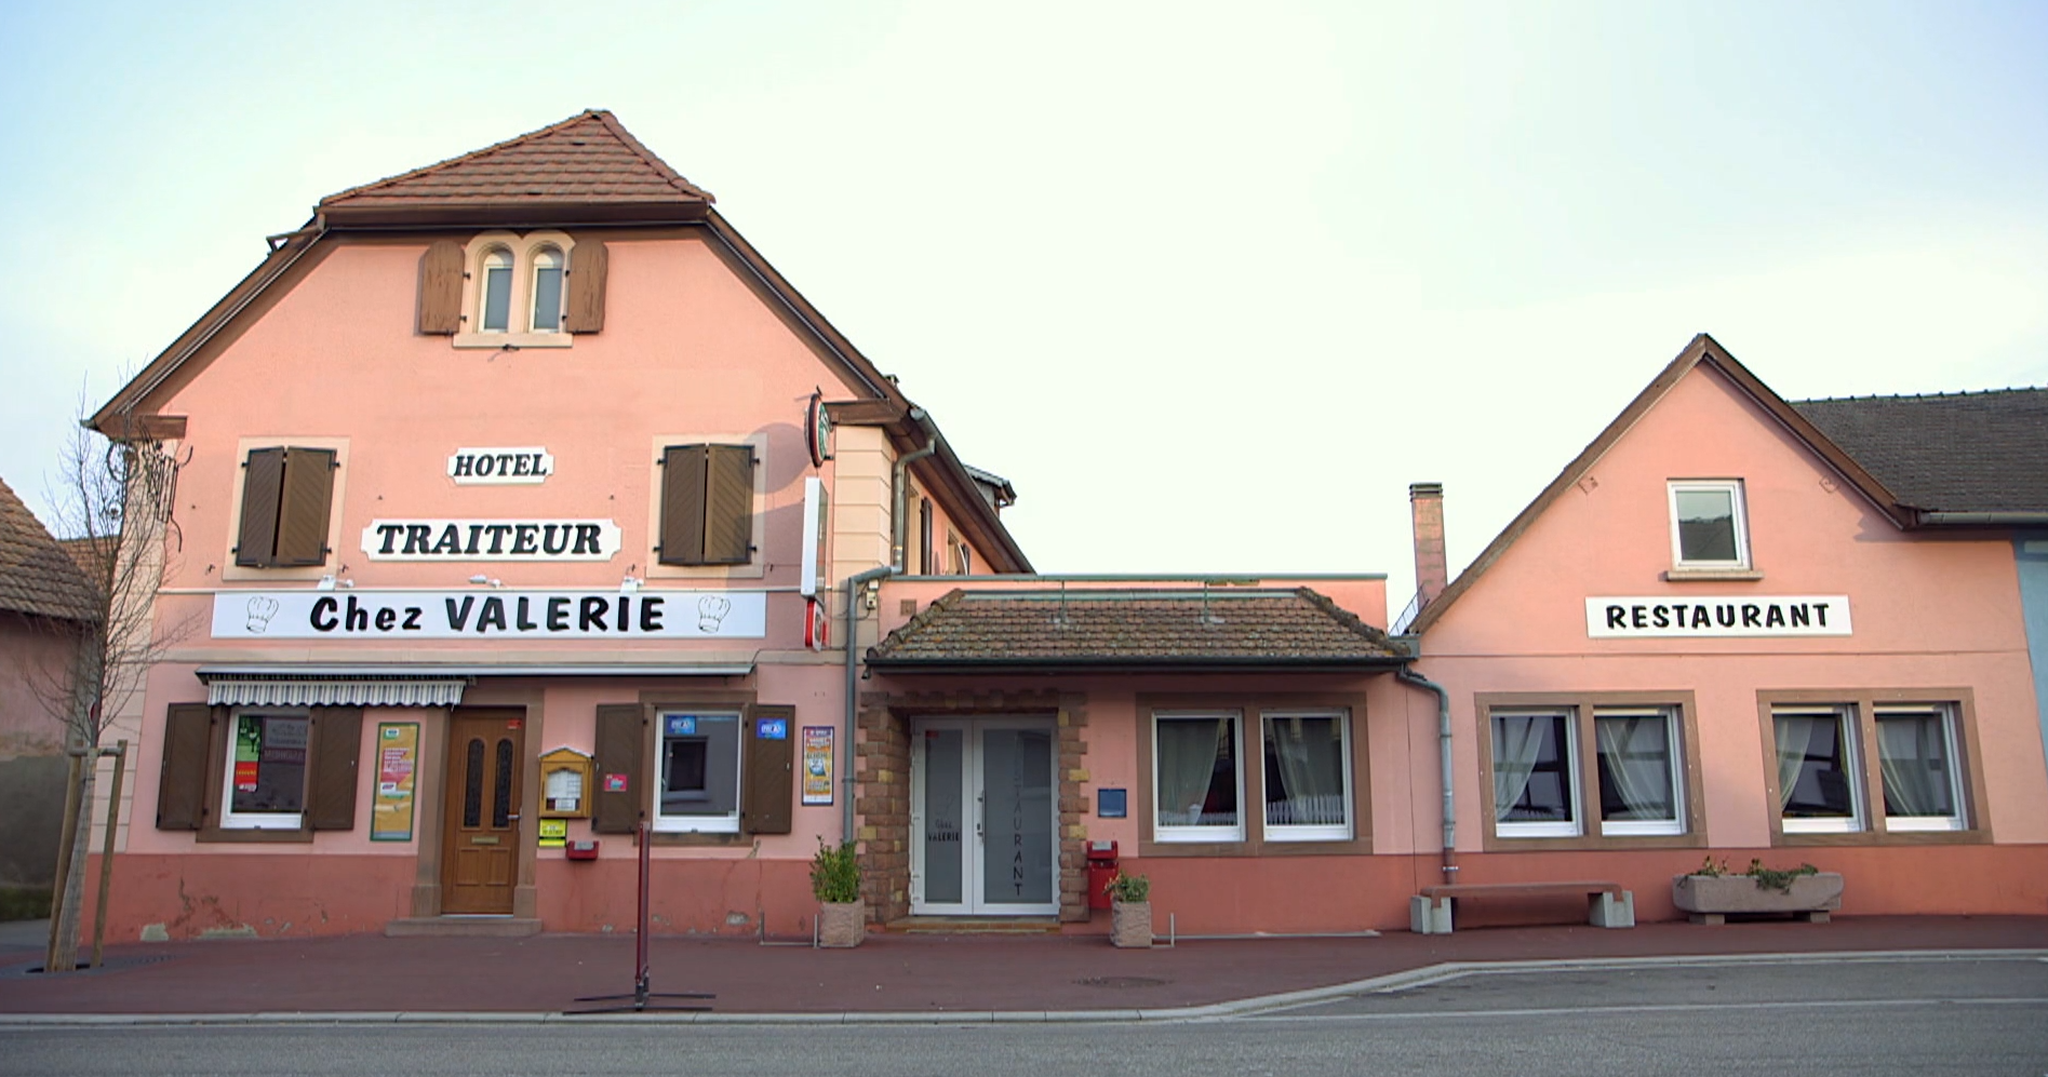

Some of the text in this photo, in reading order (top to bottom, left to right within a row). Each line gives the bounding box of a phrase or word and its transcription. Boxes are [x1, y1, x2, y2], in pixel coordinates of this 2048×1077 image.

[453, 453, 548, 477] HOTEL
[376, 523, 602, 555] TRAITEUR
[309, 595, 665, 633] Chez VALERIE
[1606, 603, 1830, 629] RESTAURANT
[928, 831, 959, 842] VALERIE
